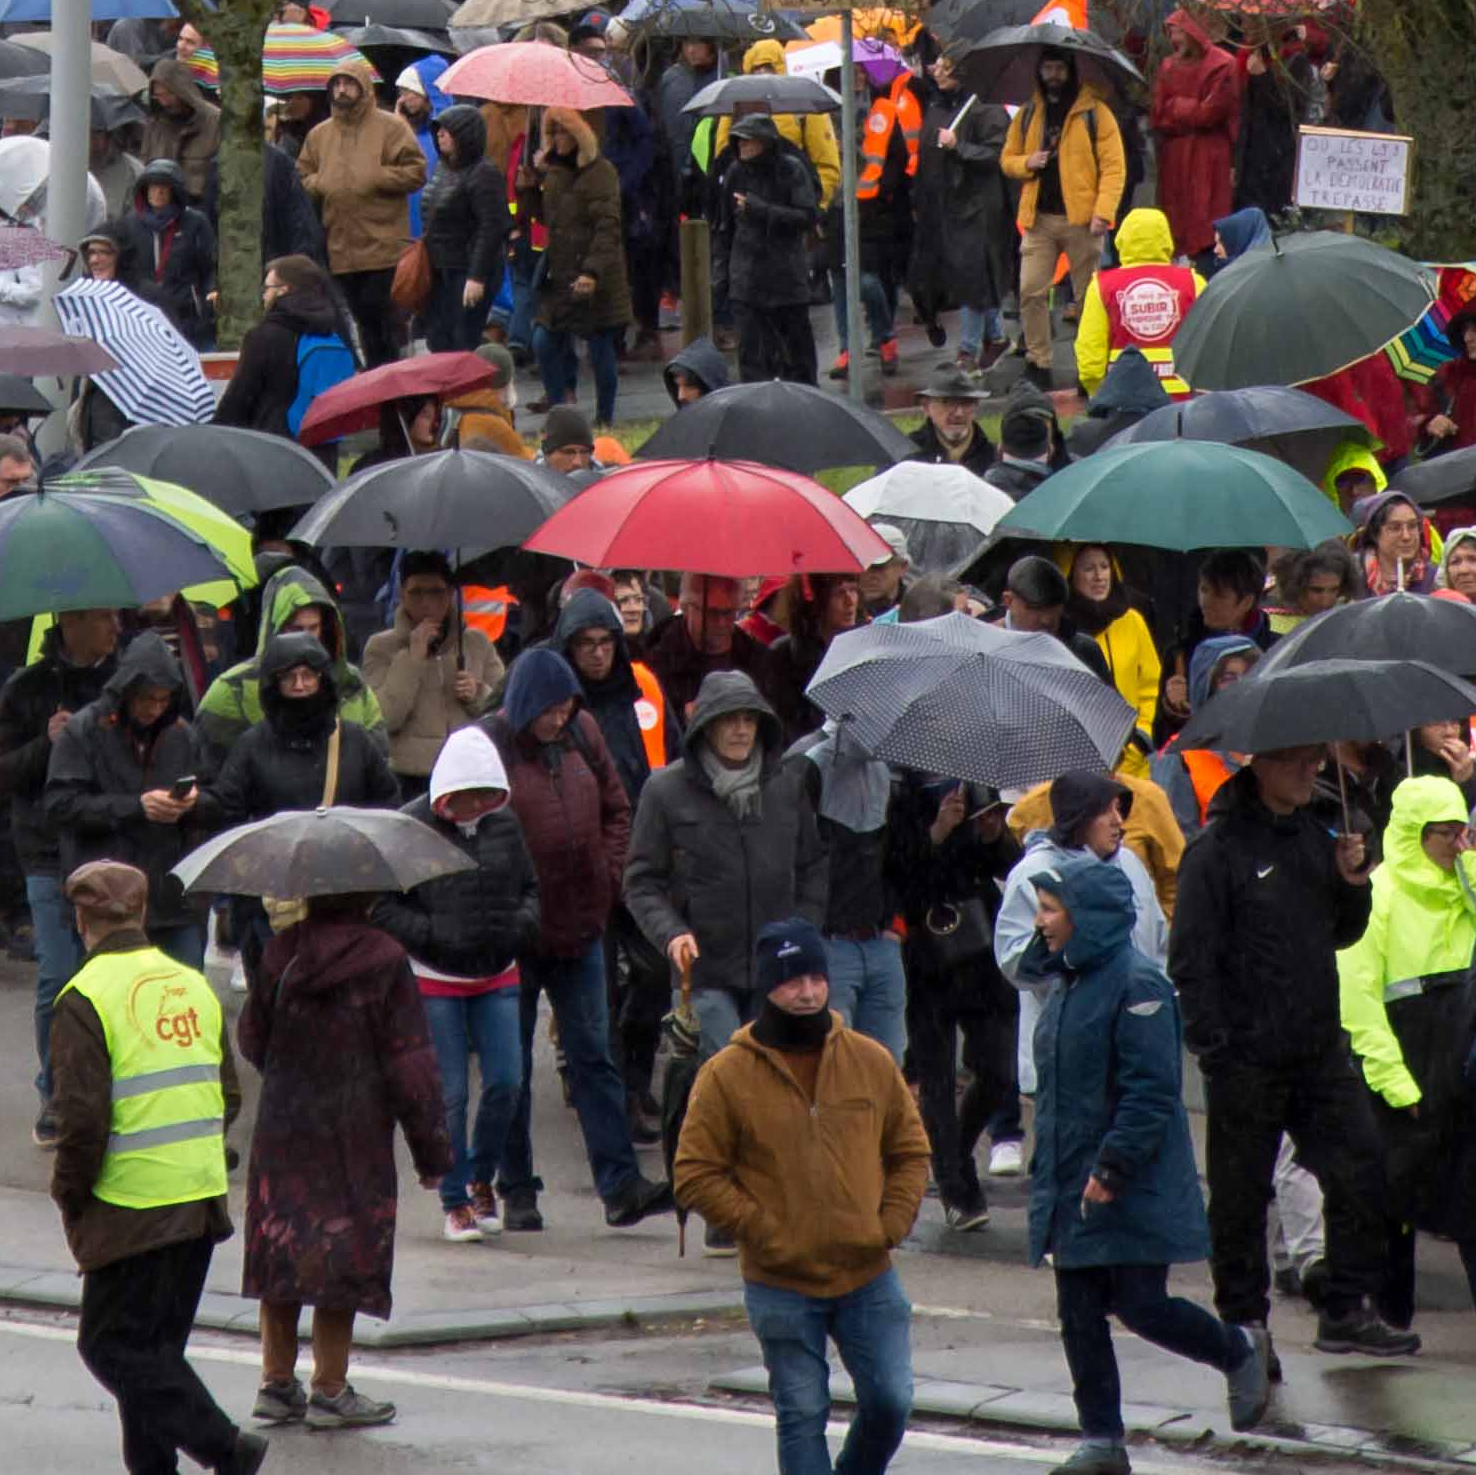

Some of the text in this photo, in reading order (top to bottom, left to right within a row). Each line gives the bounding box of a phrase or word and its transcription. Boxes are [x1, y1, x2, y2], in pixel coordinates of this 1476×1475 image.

[1340, 138, 1364, 155] LES
[1327, 156, 1390, 175] PASSENT
[1131, 302, 1168, 315] SUBIR
[156, 1007, 202, 1048] cgt
